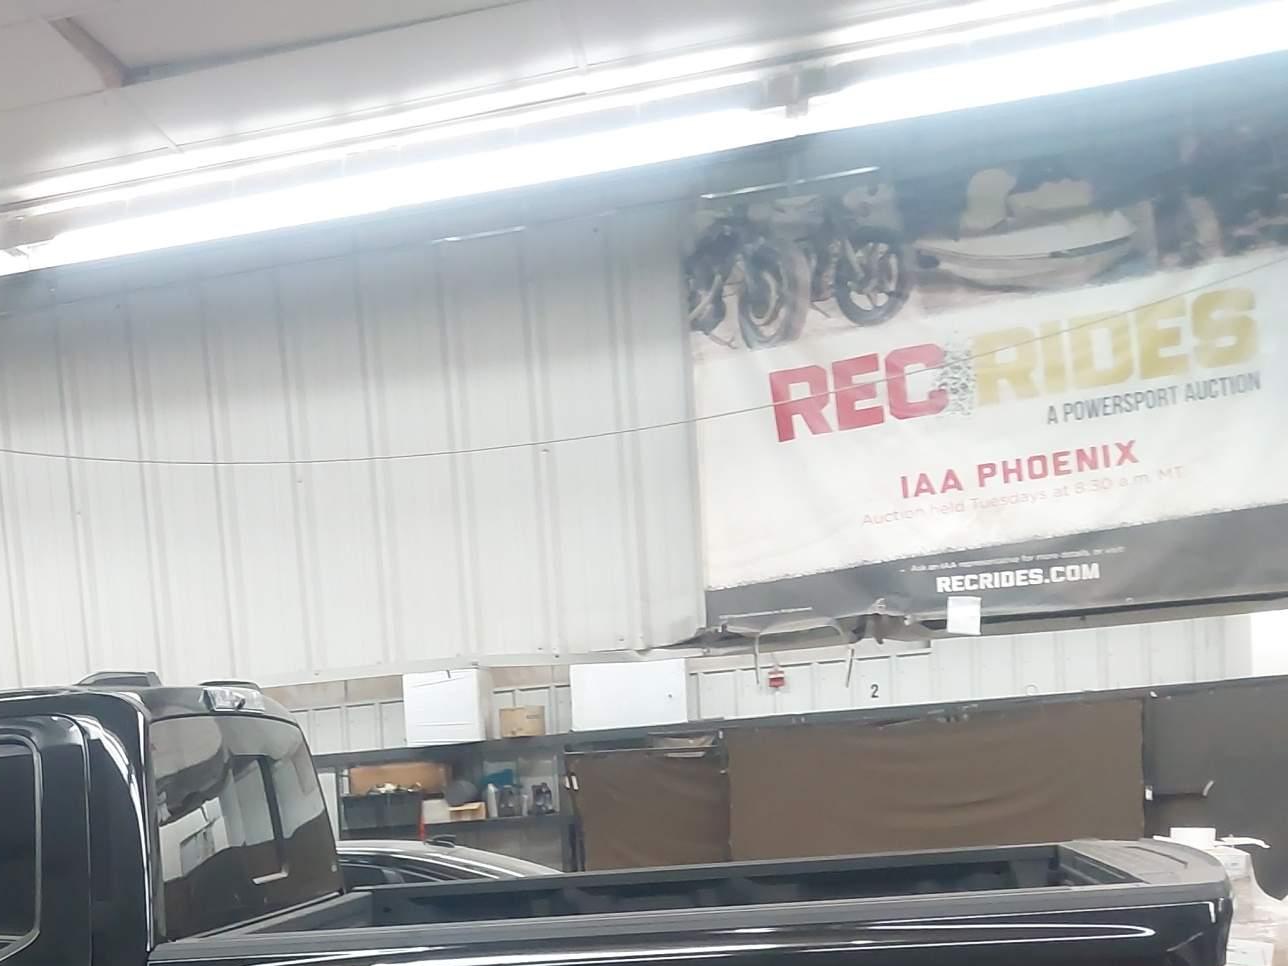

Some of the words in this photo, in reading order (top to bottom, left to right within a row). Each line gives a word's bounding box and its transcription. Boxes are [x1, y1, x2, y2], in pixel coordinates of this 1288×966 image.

[769, 343, 949, 442] REC
[973, 287, 1256, 407] RIDES
[1047, 405, 1059, 425] A
[1063, 386, 1179, 422] POWERSPORT
[1184, 371, 1262, 402] AUCTION
[900, 469, 964, 499] IAA
[976, 440, 1139, 487] PHOENIX
[862, 508, 926, 526] Auction
[970, 487, 1048, 511] Tuesdays
[1052, 485, 1070, 499] at
[1074, 477, 1113, 495] 830
[936, 563, 1101, 593] RECRIDES.COM
[870, 684, 880, 699] 2
